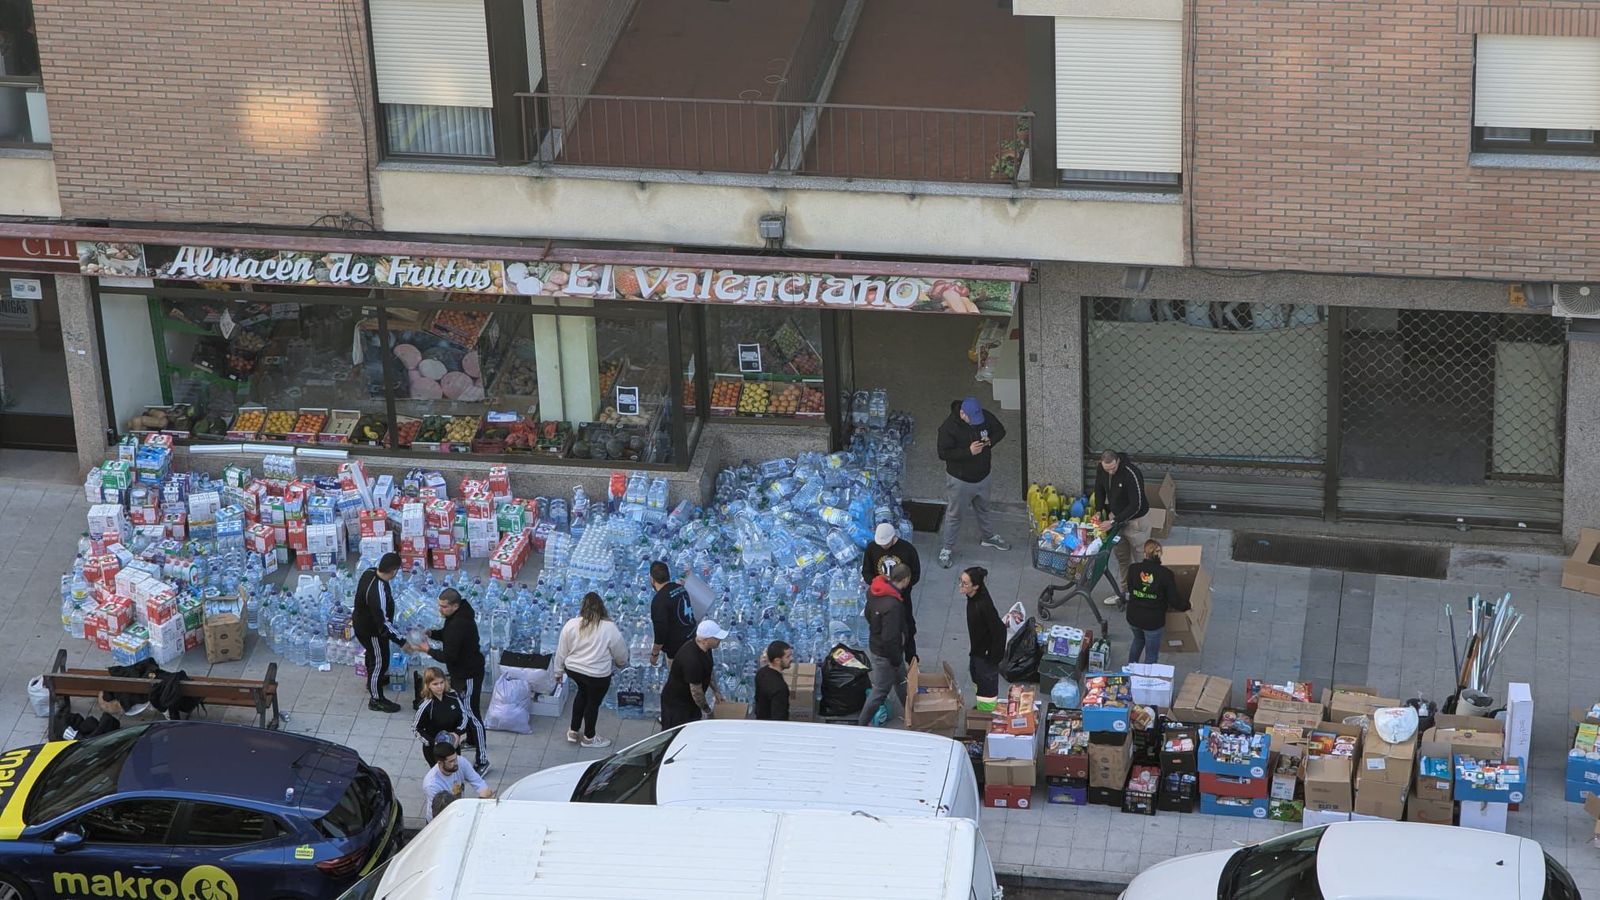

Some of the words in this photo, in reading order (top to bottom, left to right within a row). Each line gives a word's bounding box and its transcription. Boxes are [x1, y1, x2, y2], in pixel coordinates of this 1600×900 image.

[22, 238, 80, 257] CLI
[168, 246, 314, 281] Almacén
[329, 253, 370, 284] de
[387, 256, 491, 290] Frutas
[562, 263, 611, 295] El
[632, 266, 920, 308] Valenciano
